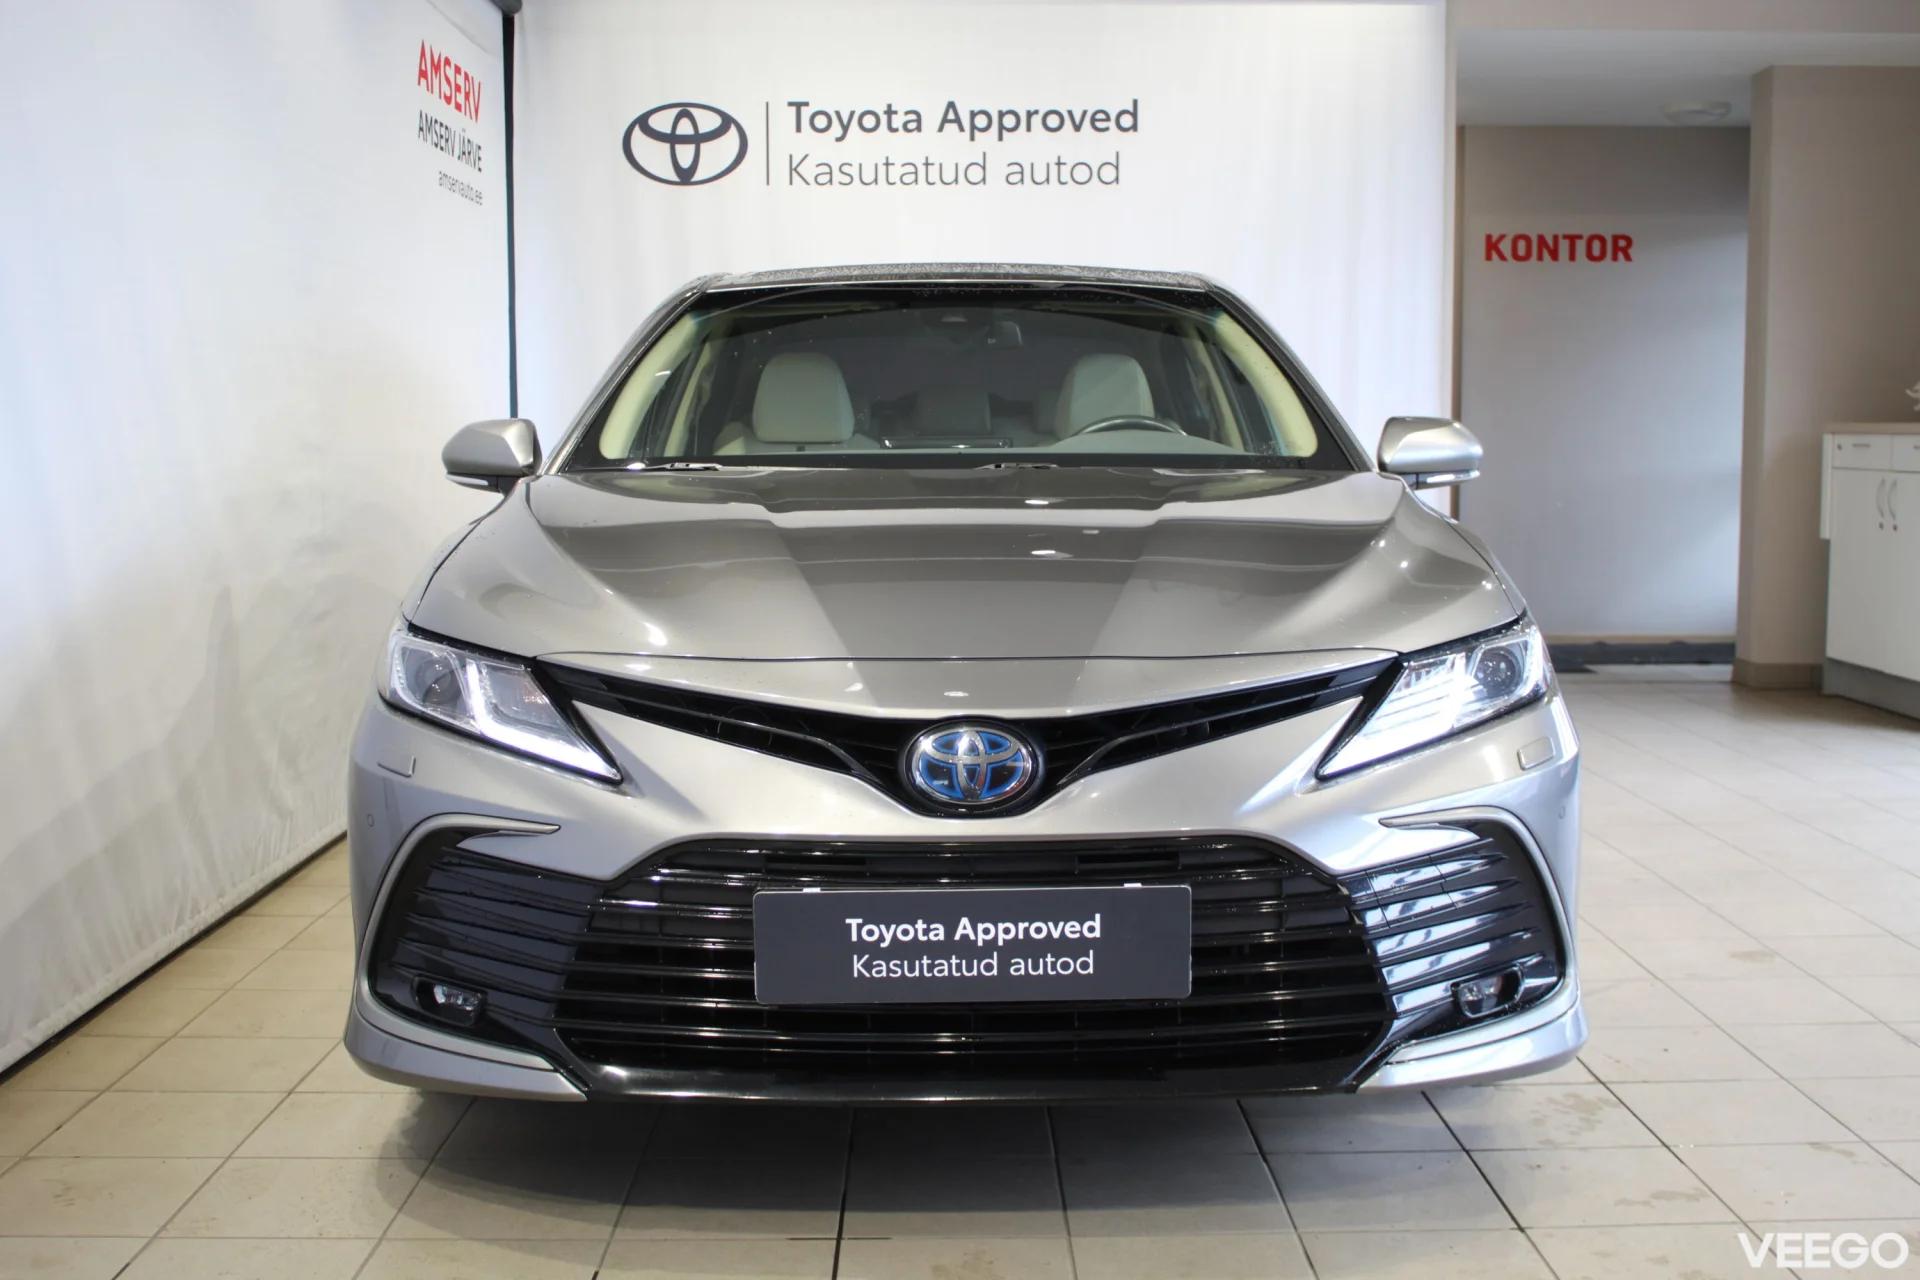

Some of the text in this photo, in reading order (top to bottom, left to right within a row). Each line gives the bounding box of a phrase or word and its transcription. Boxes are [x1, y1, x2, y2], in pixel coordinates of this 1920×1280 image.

[417, 39, 482, 124] AMSERV
[787, 99, 1139, 142] Toyota Approved
[418, 109, 483, 173] AMSERV JÄRVE
[788, 151, 1121, 186] Kasutatud autod
[1484, 233, 1634, 262] KONTOR
[845, 913, 1102, 948] Toyota Approved
[852, 949, 1095, 978] Kasutatud autod
